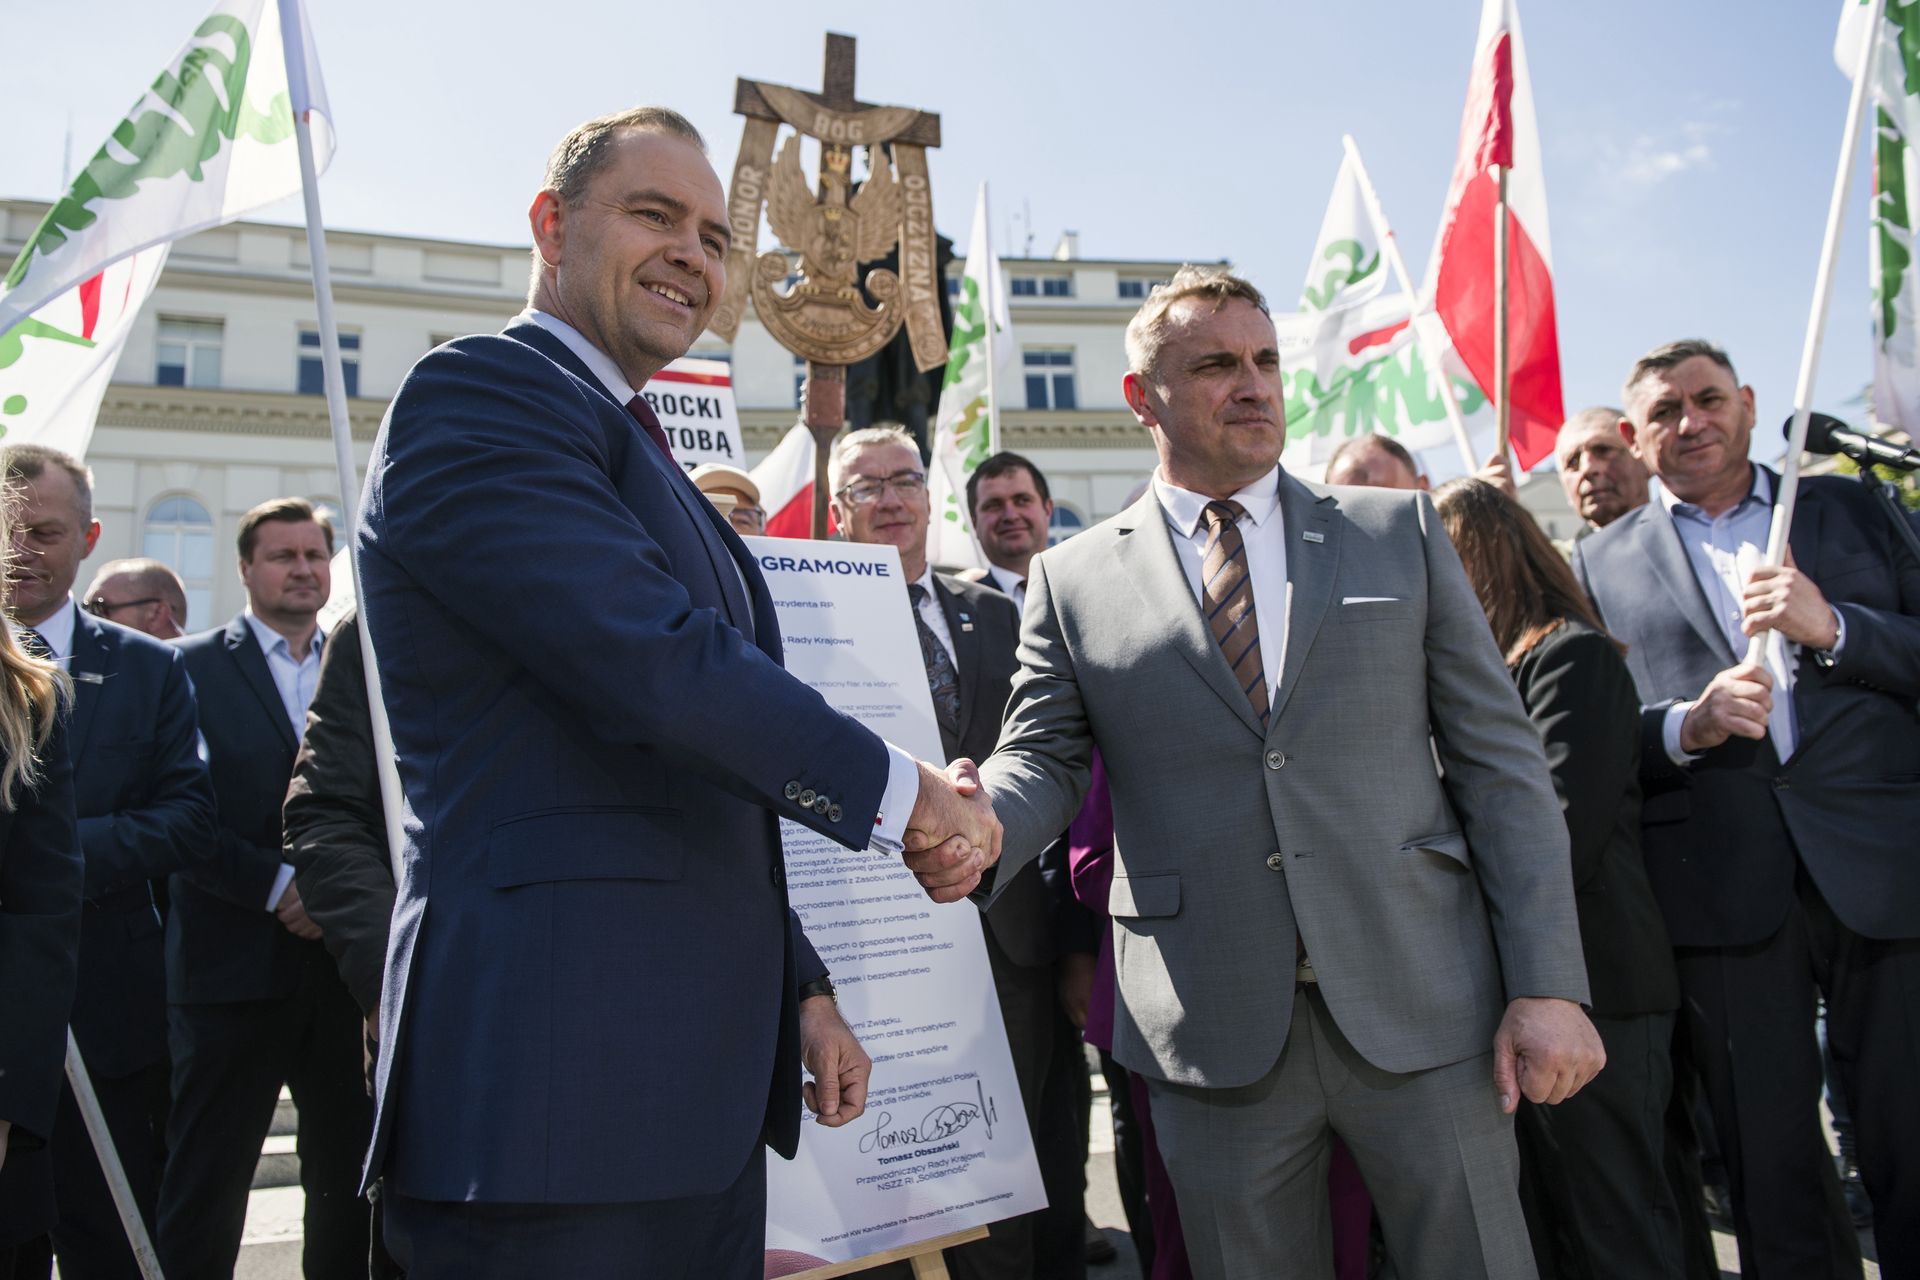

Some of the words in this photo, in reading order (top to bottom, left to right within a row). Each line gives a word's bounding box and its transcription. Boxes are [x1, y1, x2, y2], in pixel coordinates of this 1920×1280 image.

[732, 165, 763, 250] HONOR
[904, 175, 931, 302] OJCZYZNA
[663, 427, 733, 459] TOBĄ
[787, 636, 812, 645] Rady
[814, 637, 854, 647] Krajowej
[886, 1029, 905, 1038] oraz
[906, 1020, 957, 1034] sympatykom
[897, 1050, 915, 1059] oraz
[884, 1097, 898, 1106] dla
[877, 1152, 914, 1166] Tomasz
[914, 1140, 960, 1158] Obszański
[856, 1163, 926, 1185] Przewodniczący
[927, 1157, 950, 1170] Rady
[950, 1150, 986, 1164] Krajowej
[877, 1179, 904, 1191] NSZZ
[862, 1219, 899, 1234] Kandydata
[908, 1207, 945, 1223] Prezydenta
